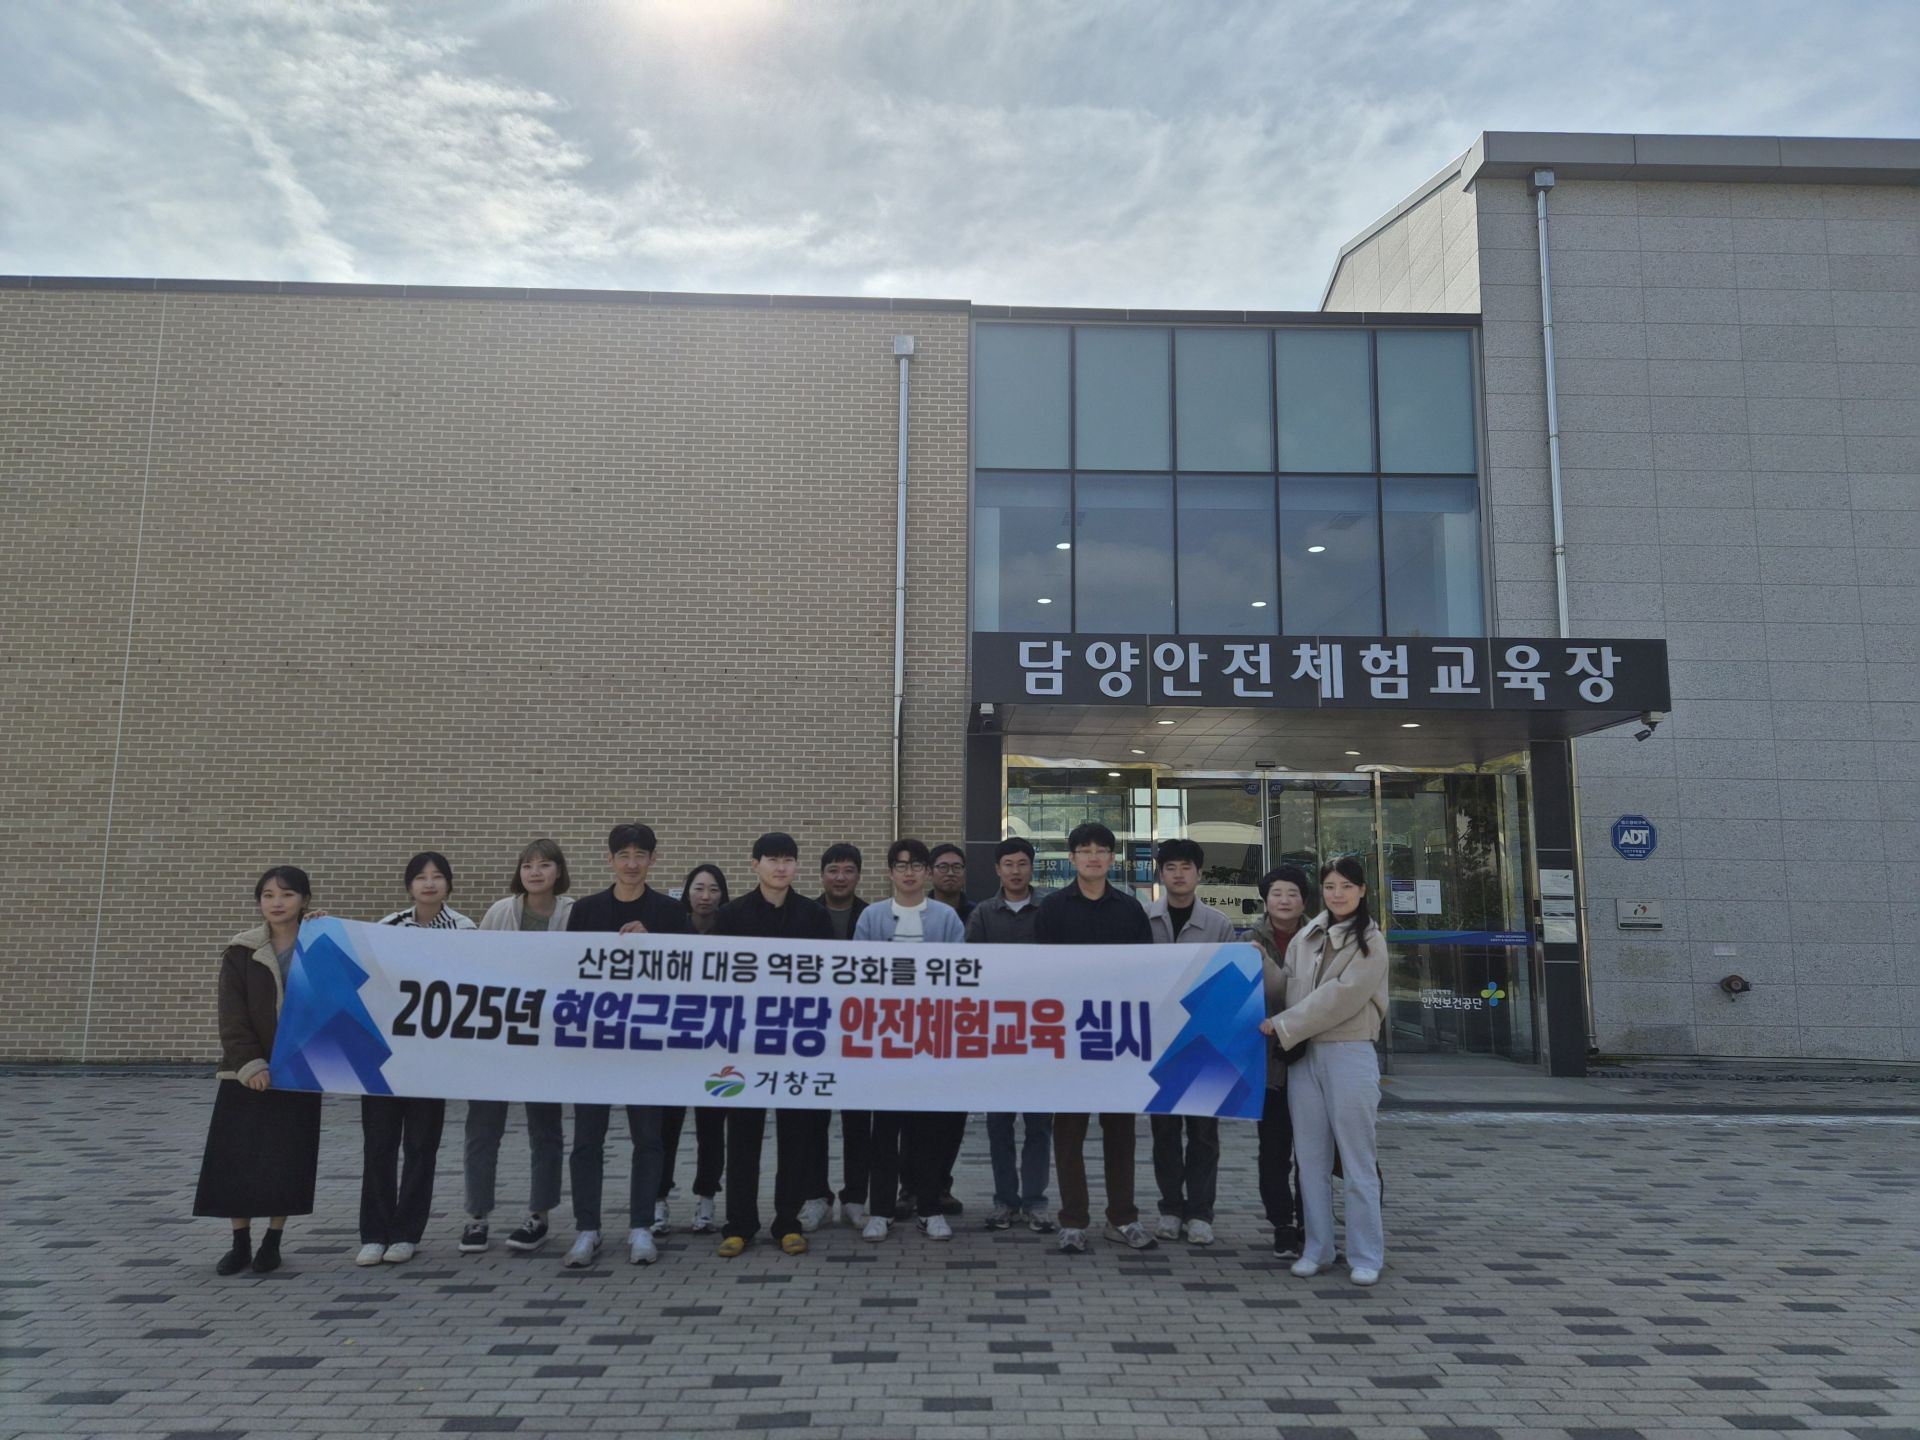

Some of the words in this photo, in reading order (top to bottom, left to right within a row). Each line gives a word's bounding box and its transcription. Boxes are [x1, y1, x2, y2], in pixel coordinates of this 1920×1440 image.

[1018, 639, 1622, 704] 담양안전체험교육장
[1619, 829, 1649, 845] ADT
[577, 947, 694, 983] 산업재해
[701, 951, 760, 984] 대응
[767, 953, 825, 985] 역량
[831, 955, 917, 987] 강화를
[925, 957, 983, 988] 위한
[1420, 996, 1483, 1010] 안전보건공단
[391, 979, 546, 1046] 2025년
[552, 989, 746, 1054] 현업근로자
[753, 996, 832, 1058] 담당
[839, 996, 1068, 1060] 안전체험교육
[1075, 999, 1152, 1062] 실시
[753, 1071, 838, 1097] 거창군
